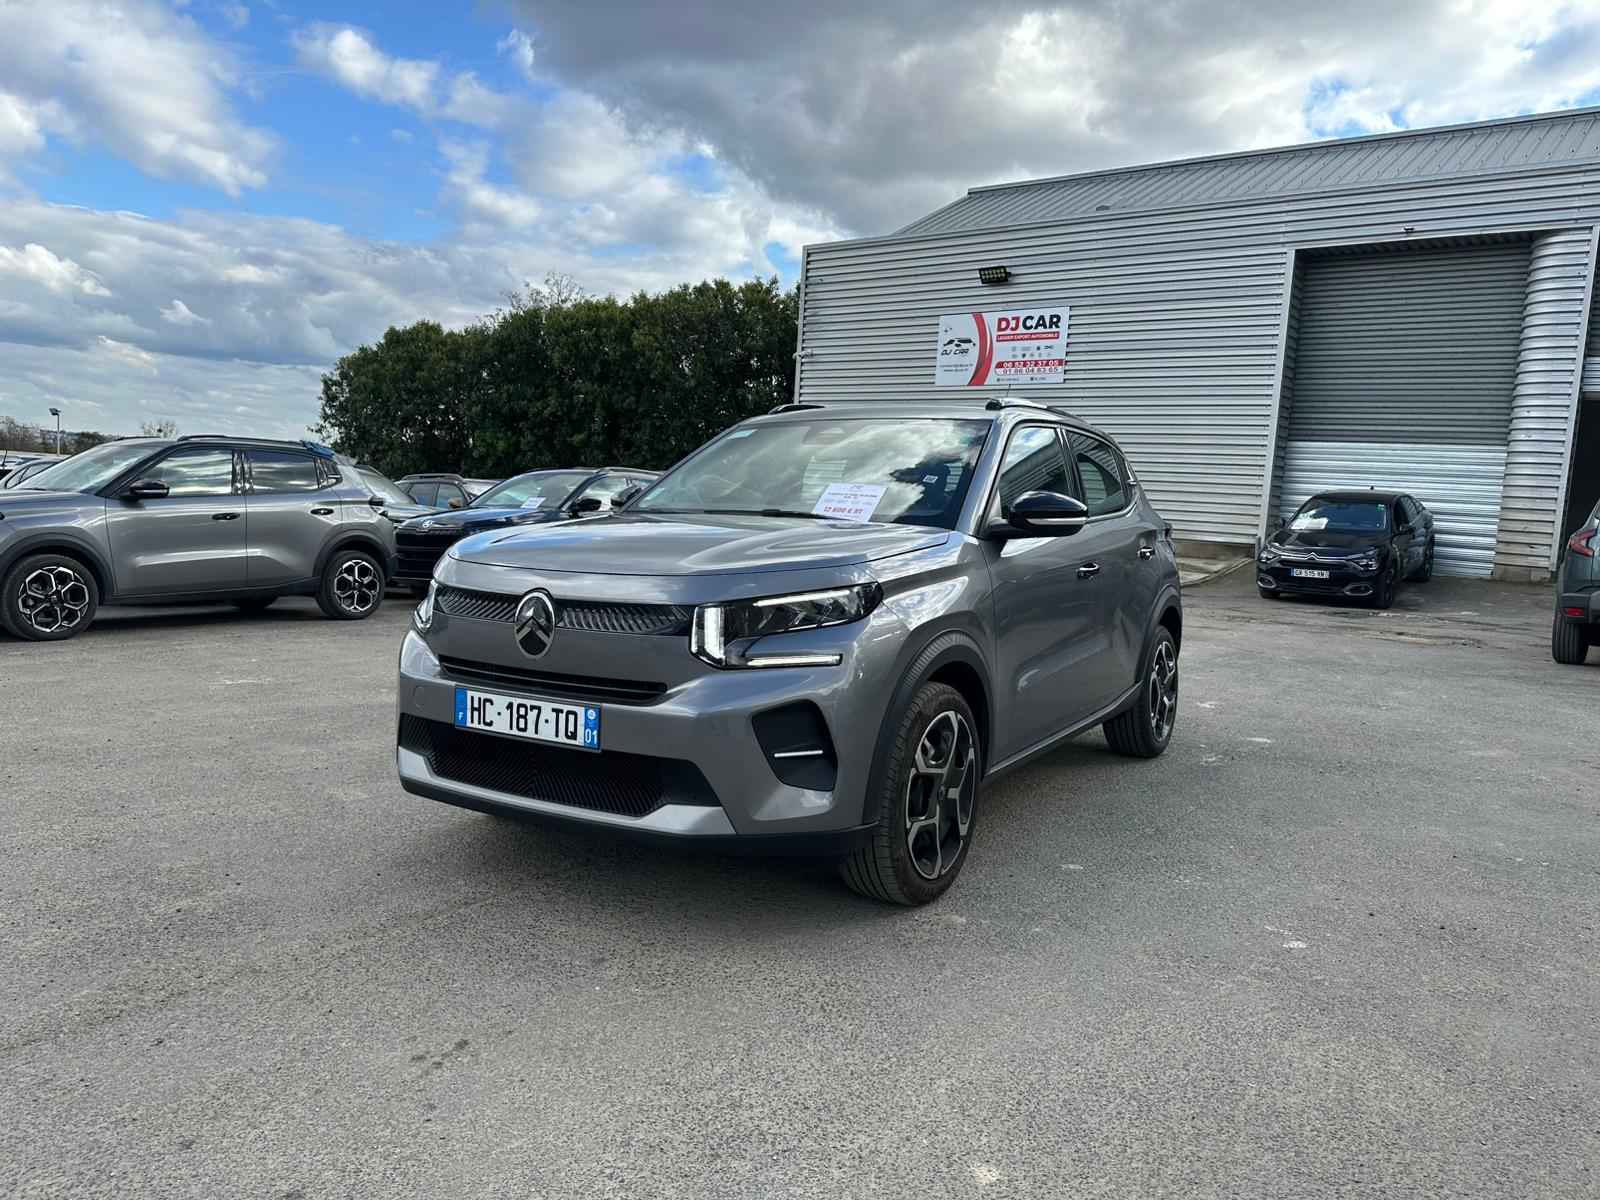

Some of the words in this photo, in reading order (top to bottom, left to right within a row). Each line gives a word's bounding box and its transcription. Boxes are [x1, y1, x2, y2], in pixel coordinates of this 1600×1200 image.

[997, 316, 1020, 332] DJ
[1022, 314, 1061, 330] CAR
[585, 728, 598, 744] 01
